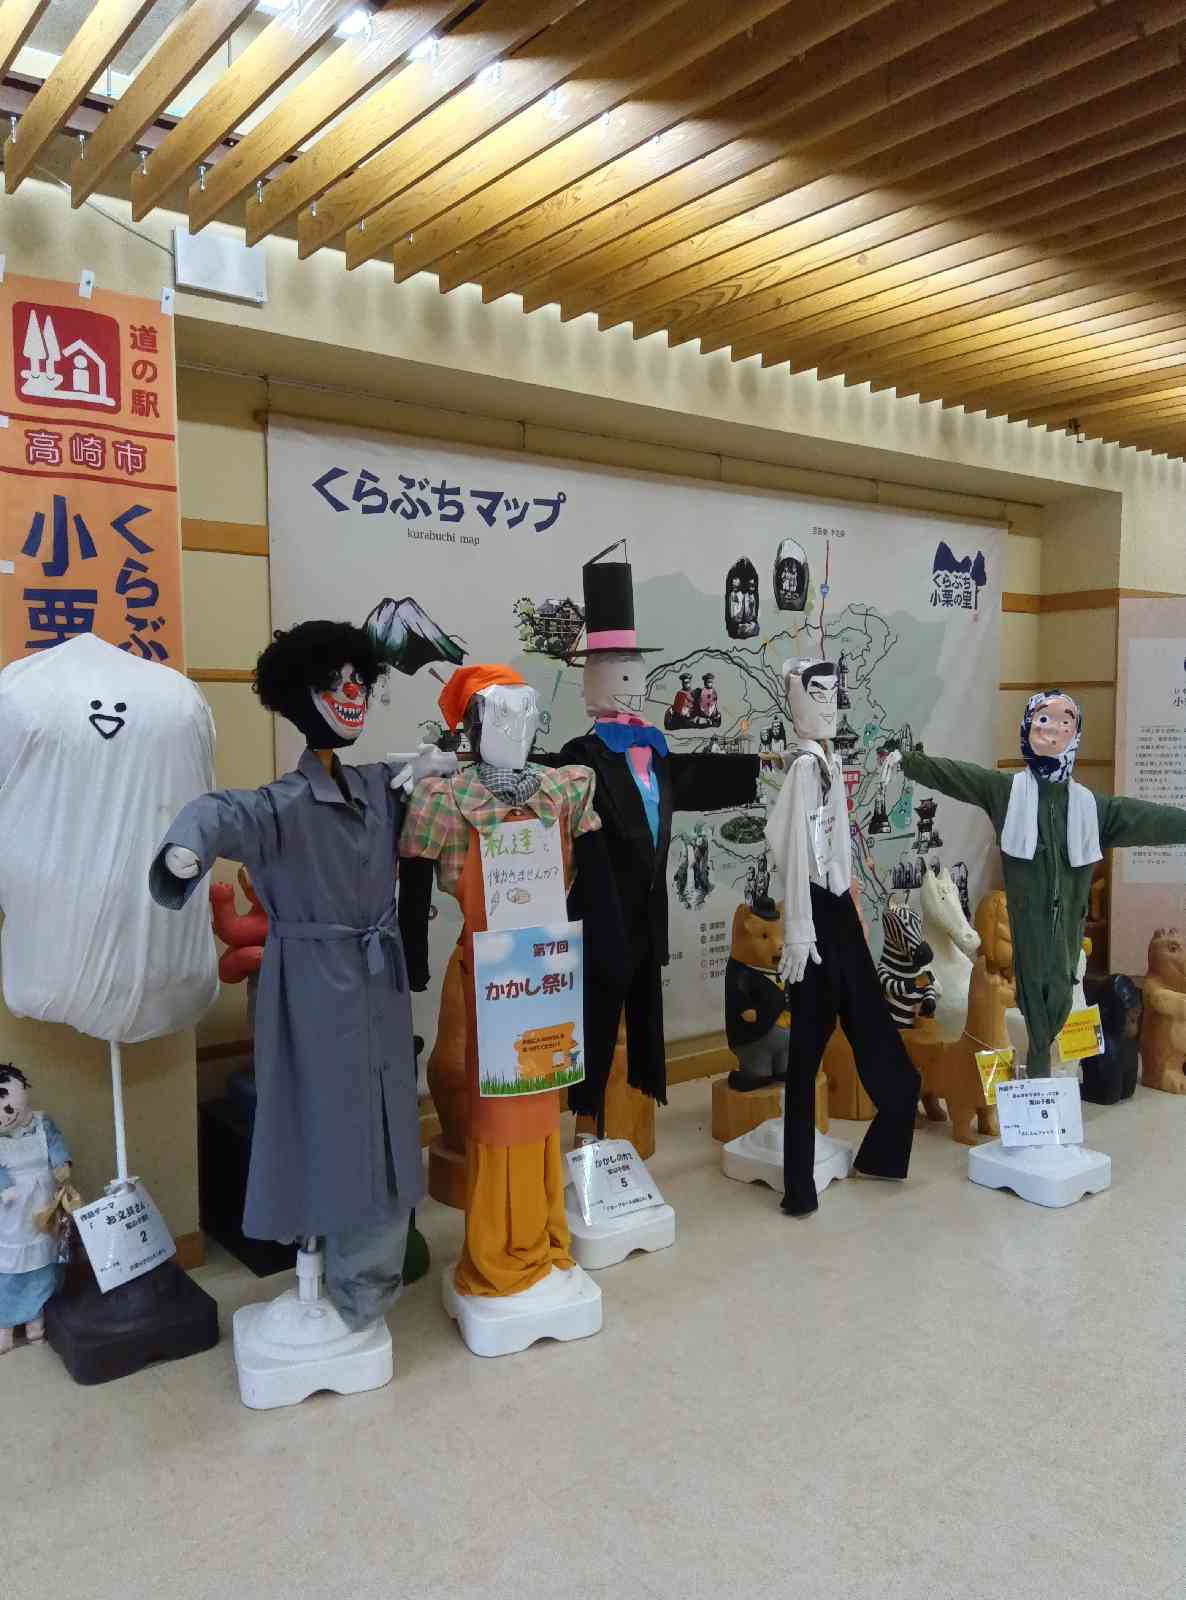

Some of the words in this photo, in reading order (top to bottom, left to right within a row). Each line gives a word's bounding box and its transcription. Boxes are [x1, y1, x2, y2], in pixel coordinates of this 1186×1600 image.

[129, 323, 160, 418] 道の駅
[24, 428, 146, 475] 高崎市
[311, 466, 567, 533] くらぶちマップ
[407, 527, 456, 543] kurabuchi
[460, 534, 480, 546] map
[932, 573, 971, 589] くらぶち
[930, 589, 973, 610] 小栗の里
[533, 940, 569, 957] 第7回
[485, 972, 574, 1001] かかし祭り
[1041, 1109, 1049, 1120] 8
[620, 1177, 629, 1188] 5
[139, 1230, 148, 1243] 2
